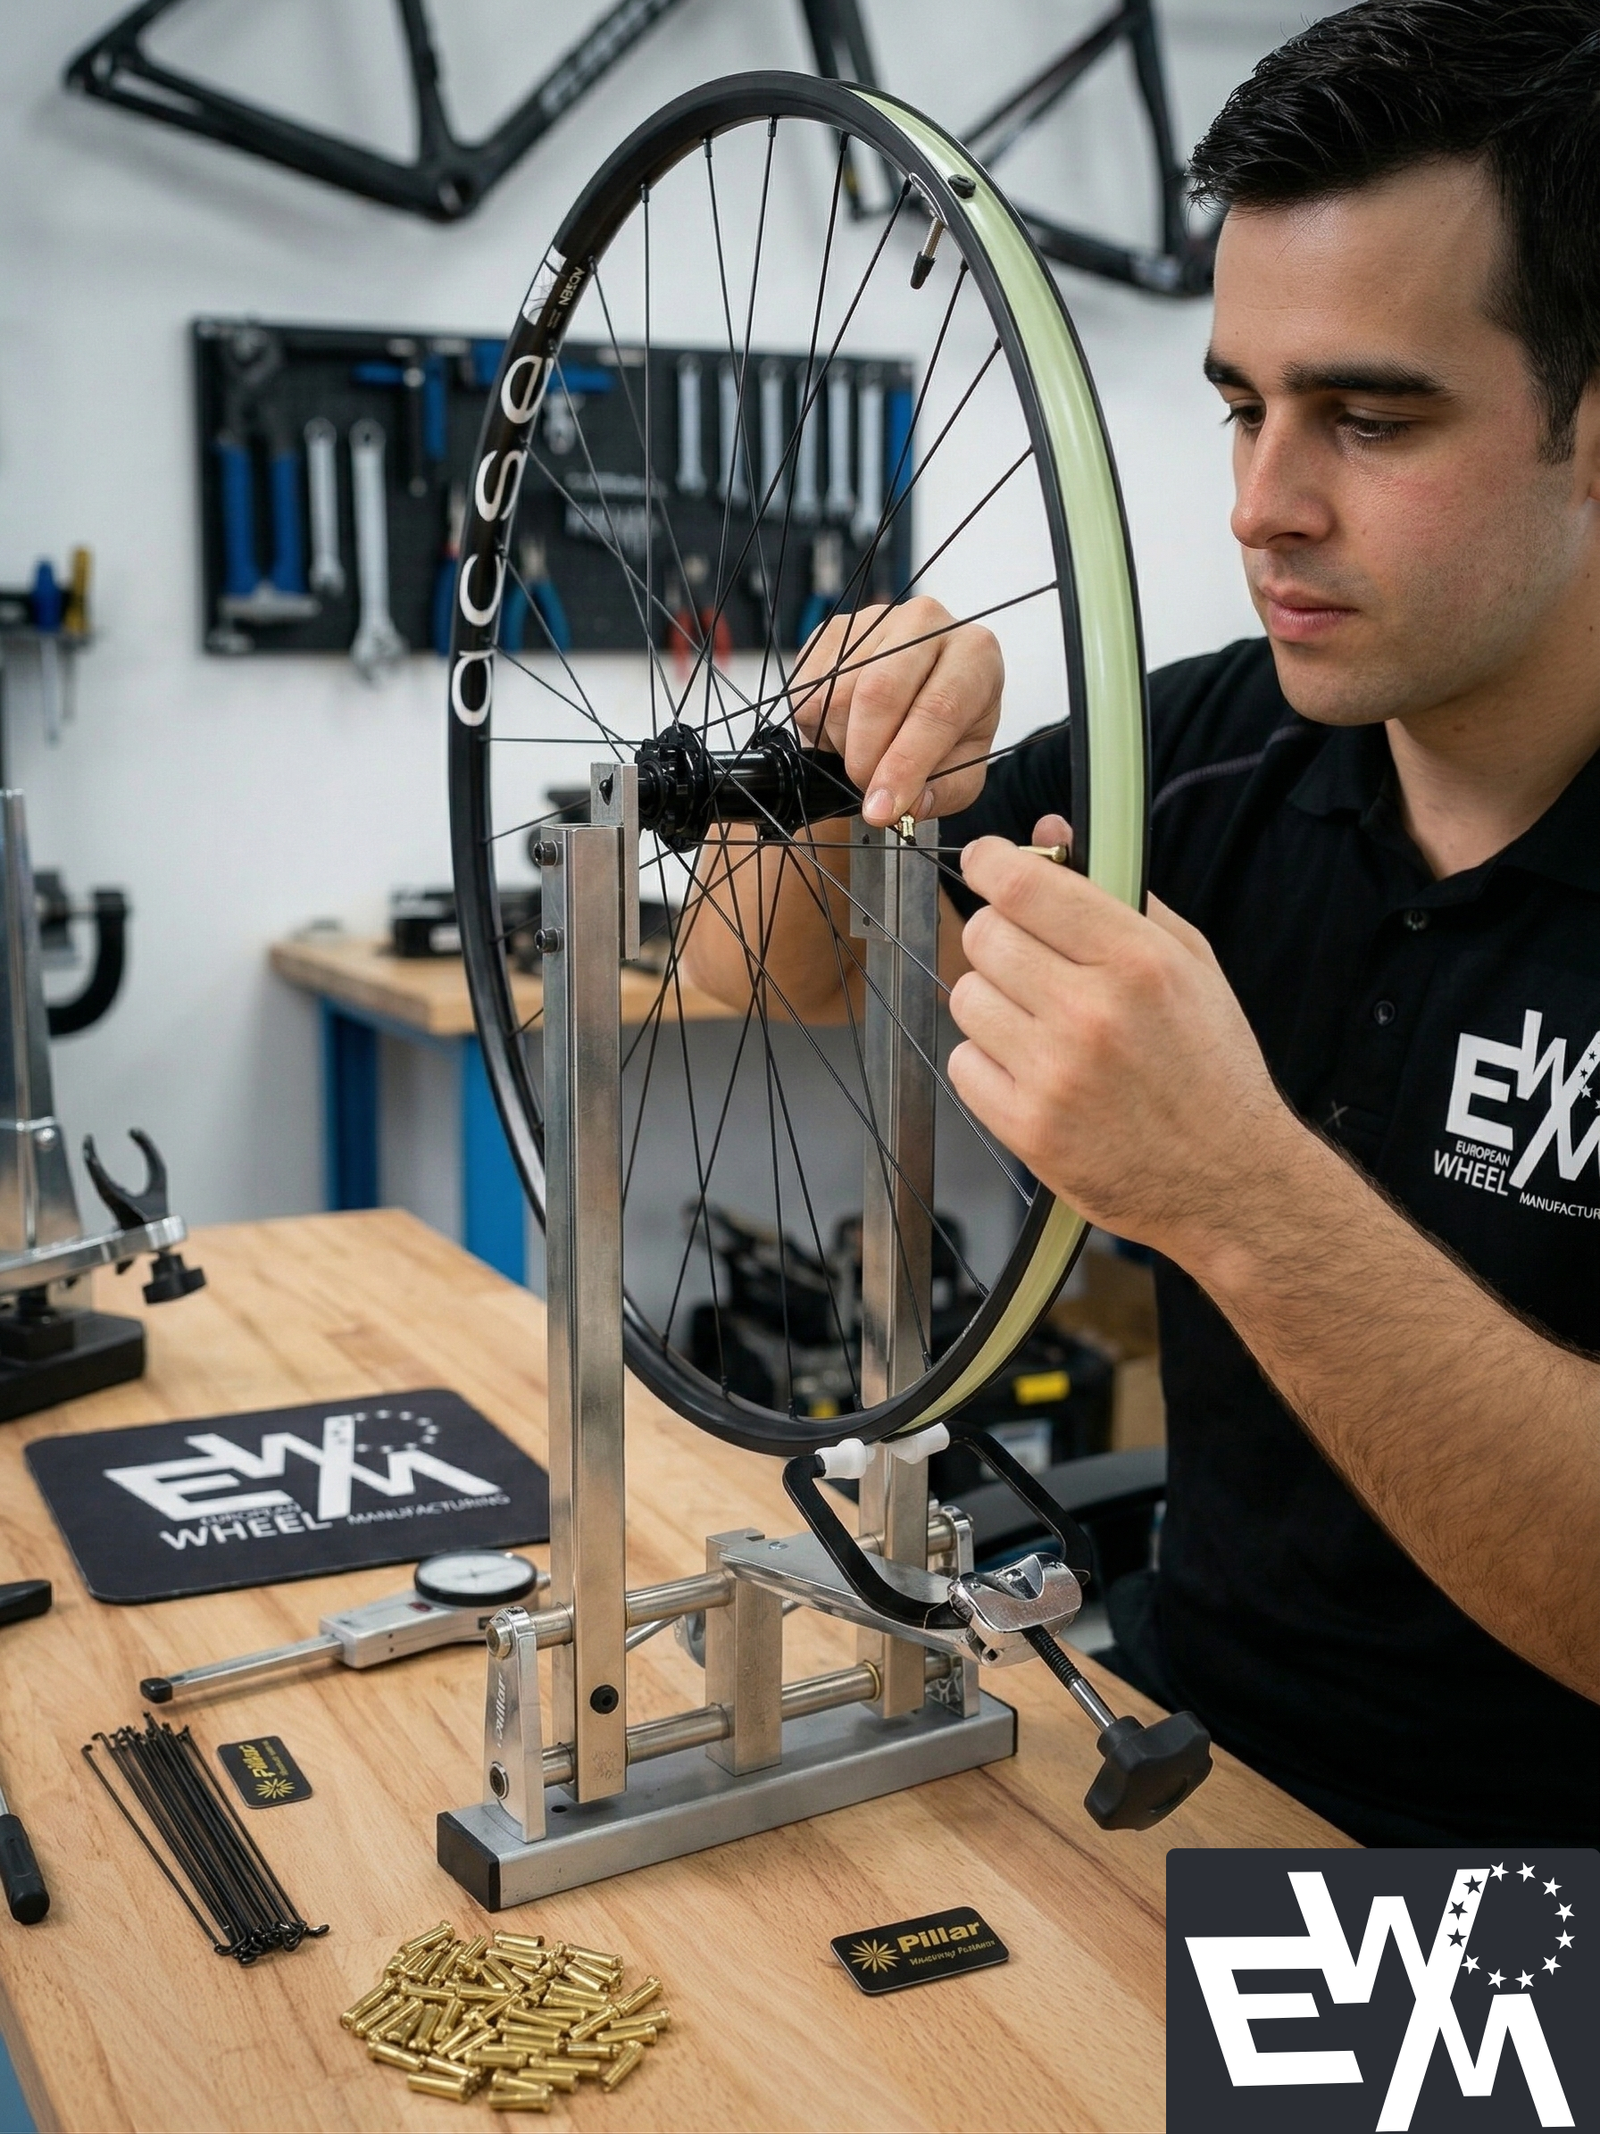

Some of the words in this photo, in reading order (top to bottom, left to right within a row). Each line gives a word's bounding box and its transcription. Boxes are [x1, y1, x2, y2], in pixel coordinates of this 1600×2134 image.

[1456, 1140, 1510, 1168] EUROPEAN
[1434, 1150, 1509, 1197] WHEEL
[160, 1511, 333, 1550] WHEEL
[897, 1921, 980, 1954] Pillar
